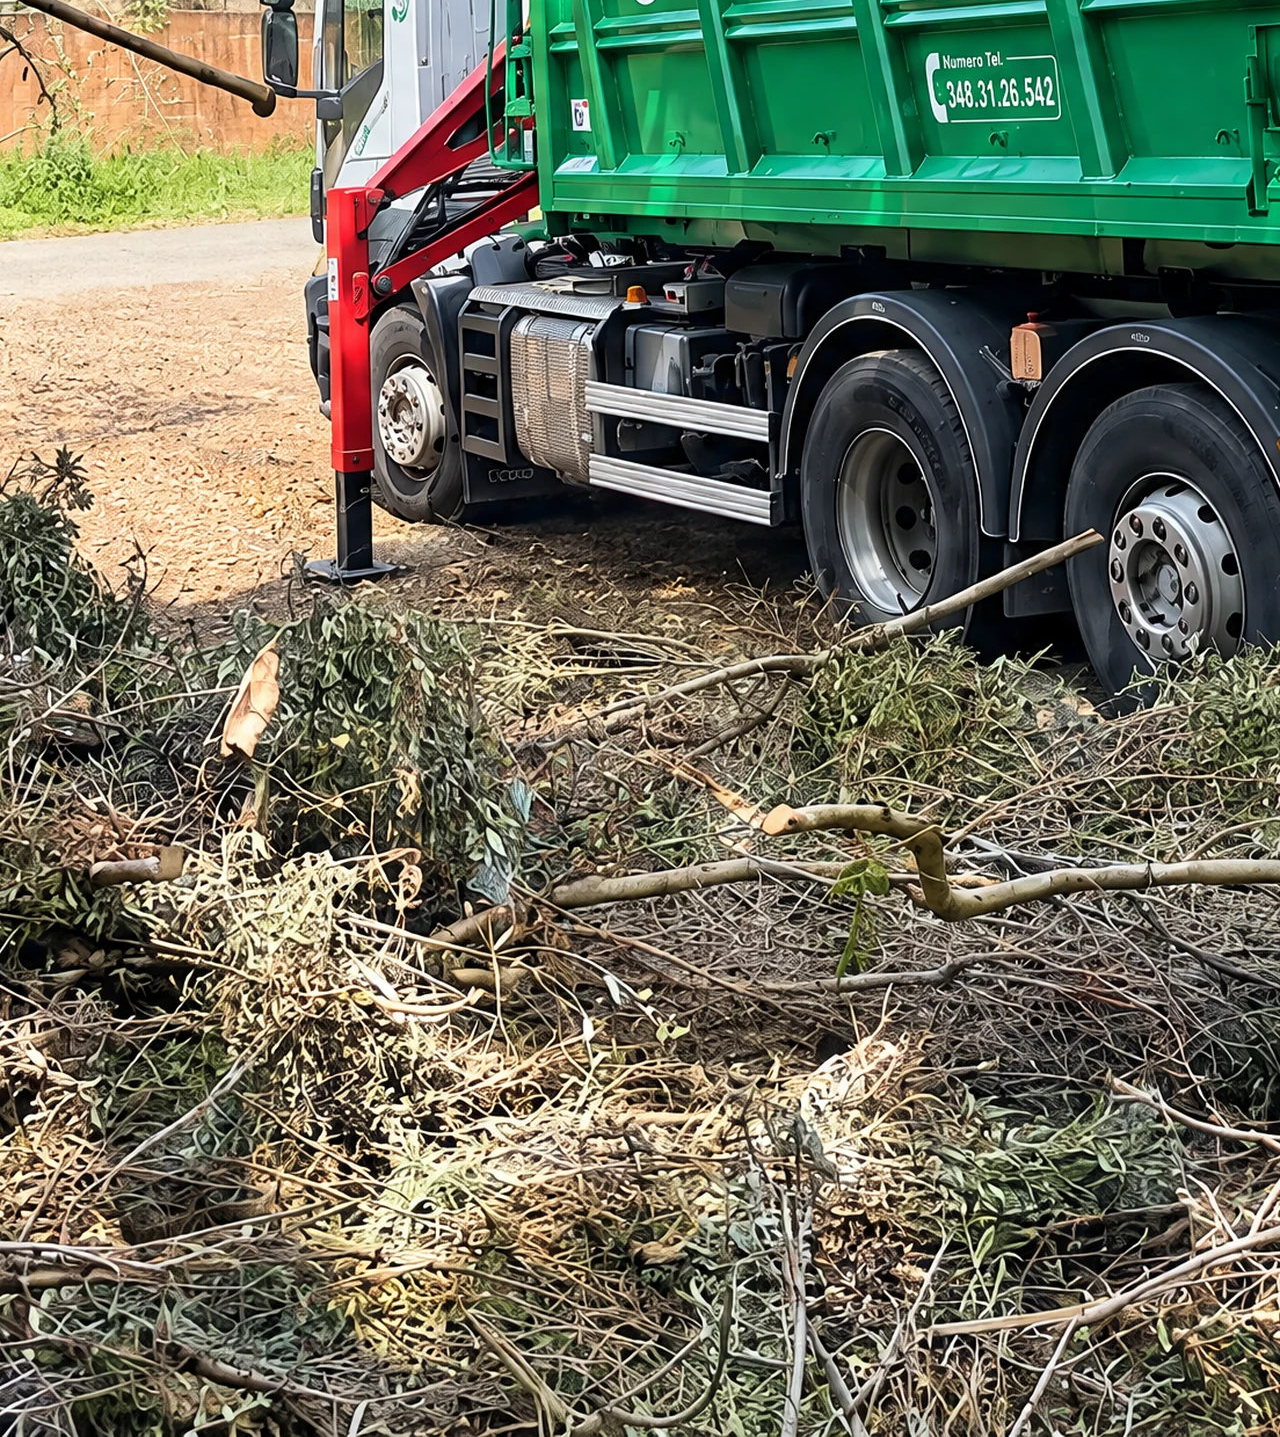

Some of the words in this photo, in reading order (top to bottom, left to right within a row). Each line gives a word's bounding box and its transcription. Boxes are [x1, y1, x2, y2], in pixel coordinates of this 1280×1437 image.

[942, 55, 983, 69] Numero
[984, 51, 1003, 66] Tel.
[946, 75, 1055, 109] 348.31.26.542
